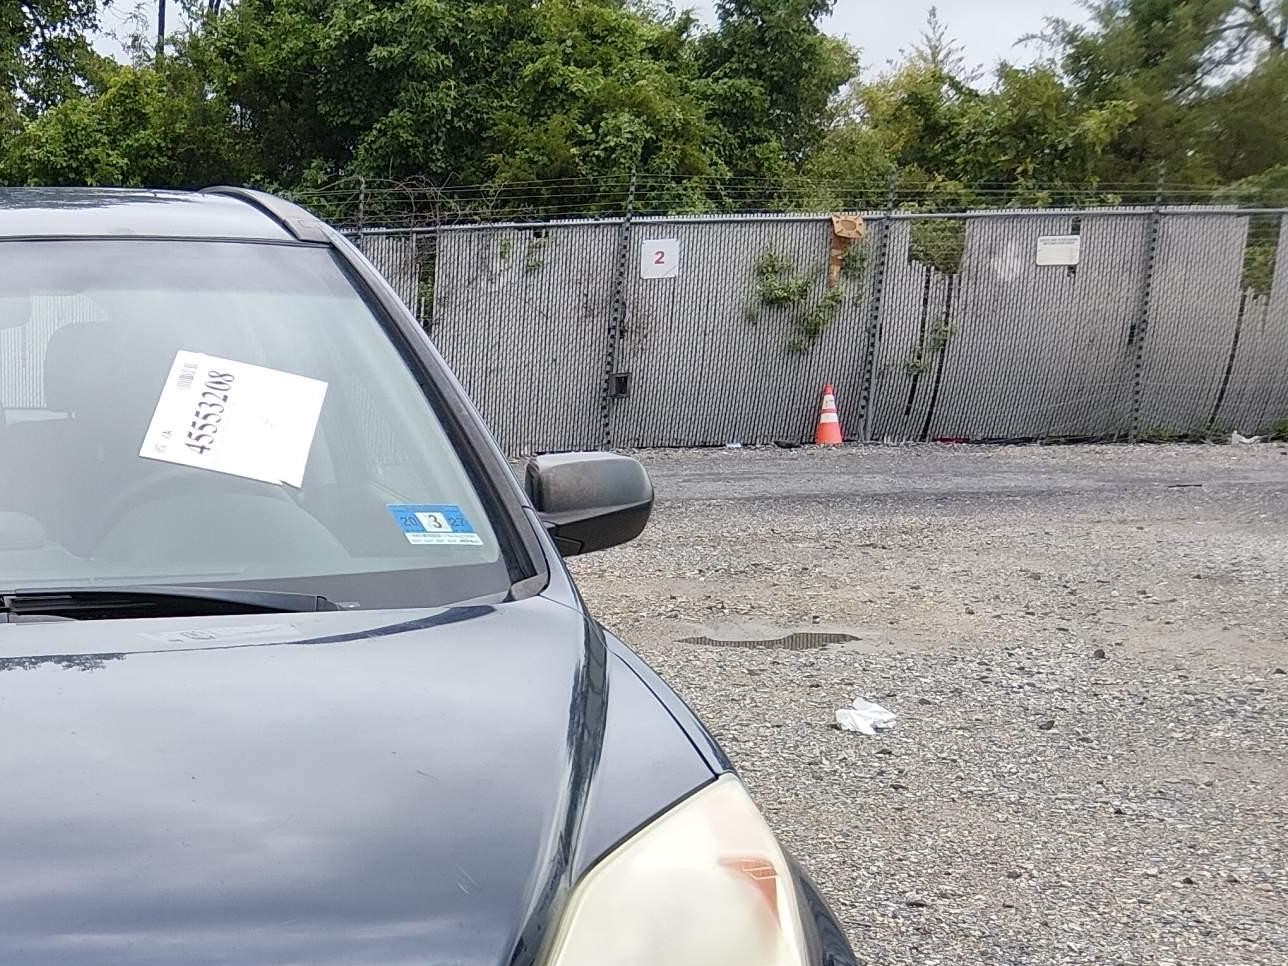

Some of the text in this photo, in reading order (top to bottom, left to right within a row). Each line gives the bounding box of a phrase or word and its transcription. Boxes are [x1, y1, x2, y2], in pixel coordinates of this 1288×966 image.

[654, 250, 665, 265] 2
[184, 369, 235, 455] 45553208
[428, 514, 443, 529] 3
